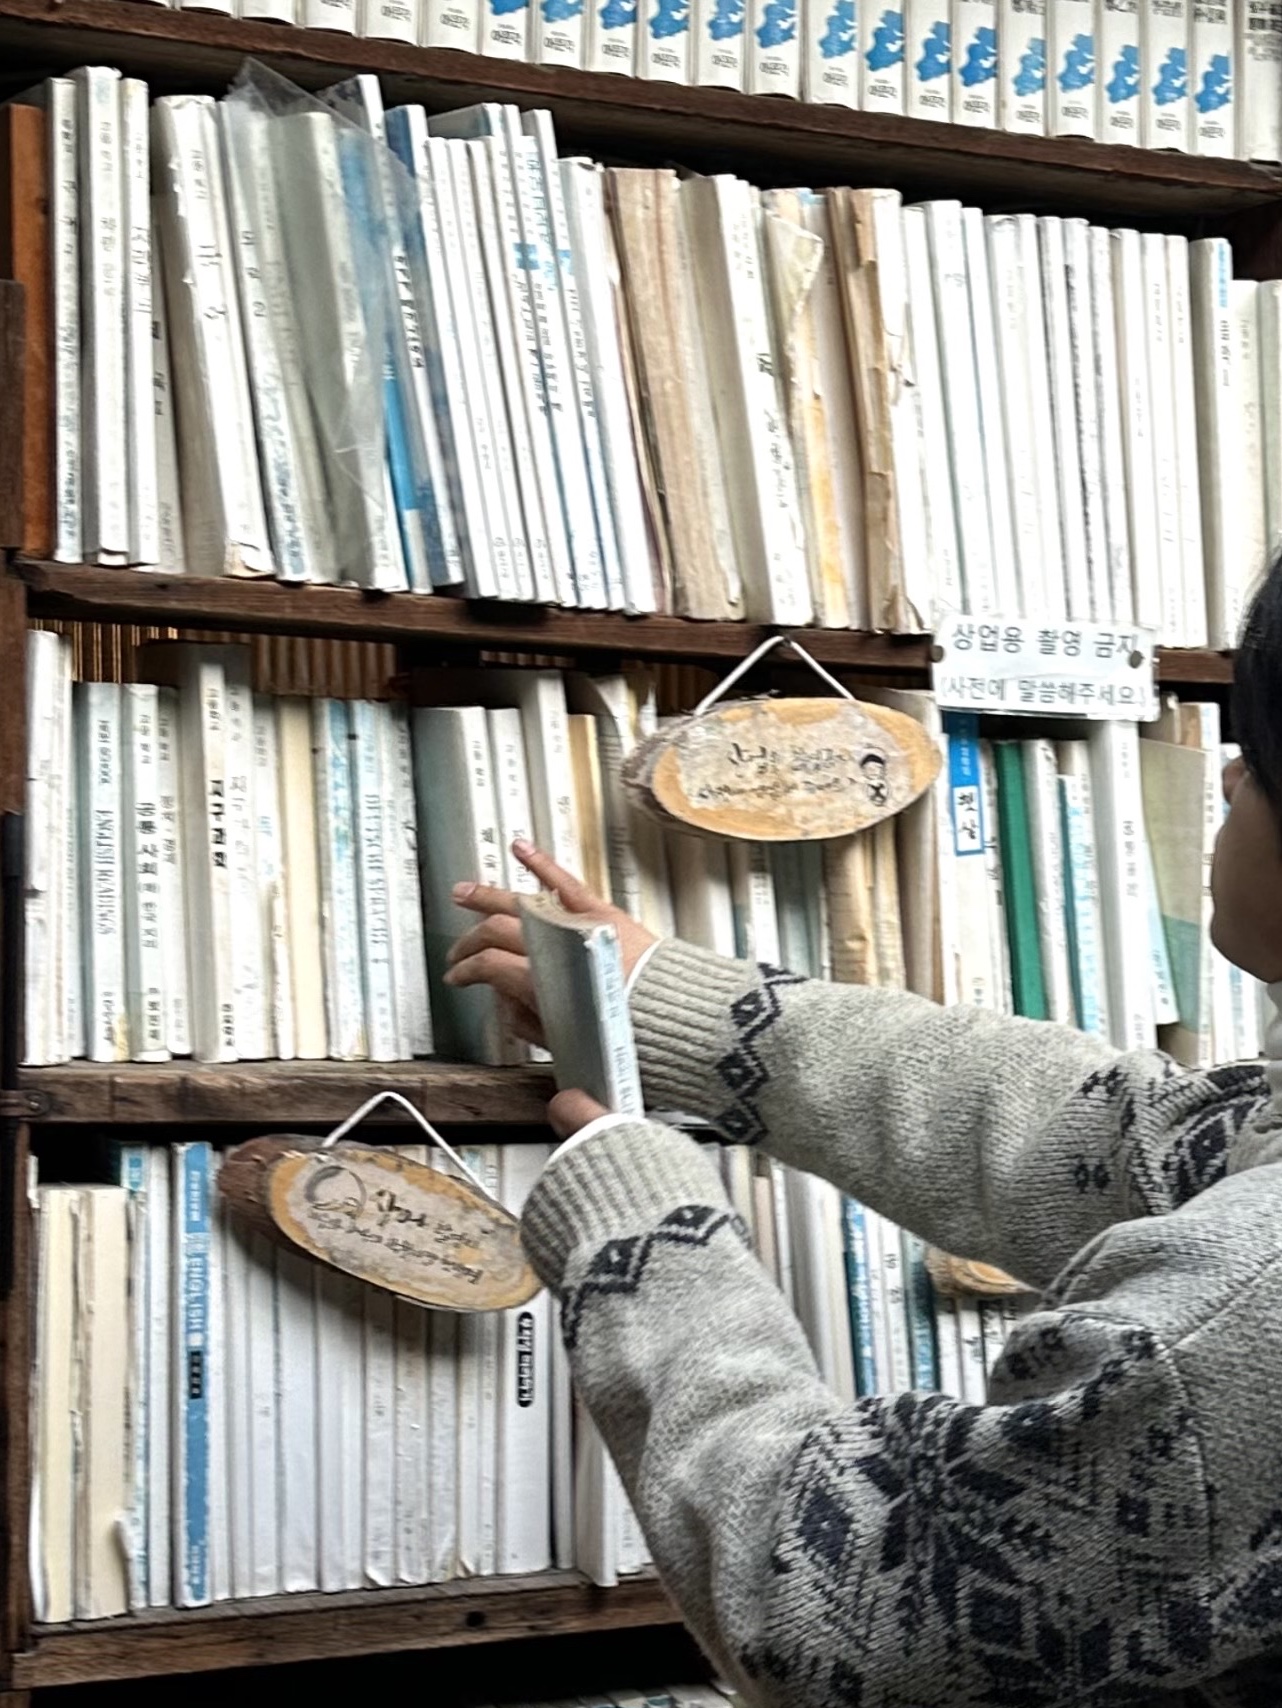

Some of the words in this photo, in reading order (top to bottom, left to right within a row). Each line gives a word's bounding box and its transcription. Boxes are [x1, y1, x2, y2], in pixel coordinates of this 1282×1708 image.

[952, 624, 1025, 654] 상업용
[1036, 629, 1083, 657] 촬영
[1093, 632, 1139, 659] 금지
[941, 677, 1006, 701] (사전에
[1018, 680, 1147, 706] 말씀해주세요)
